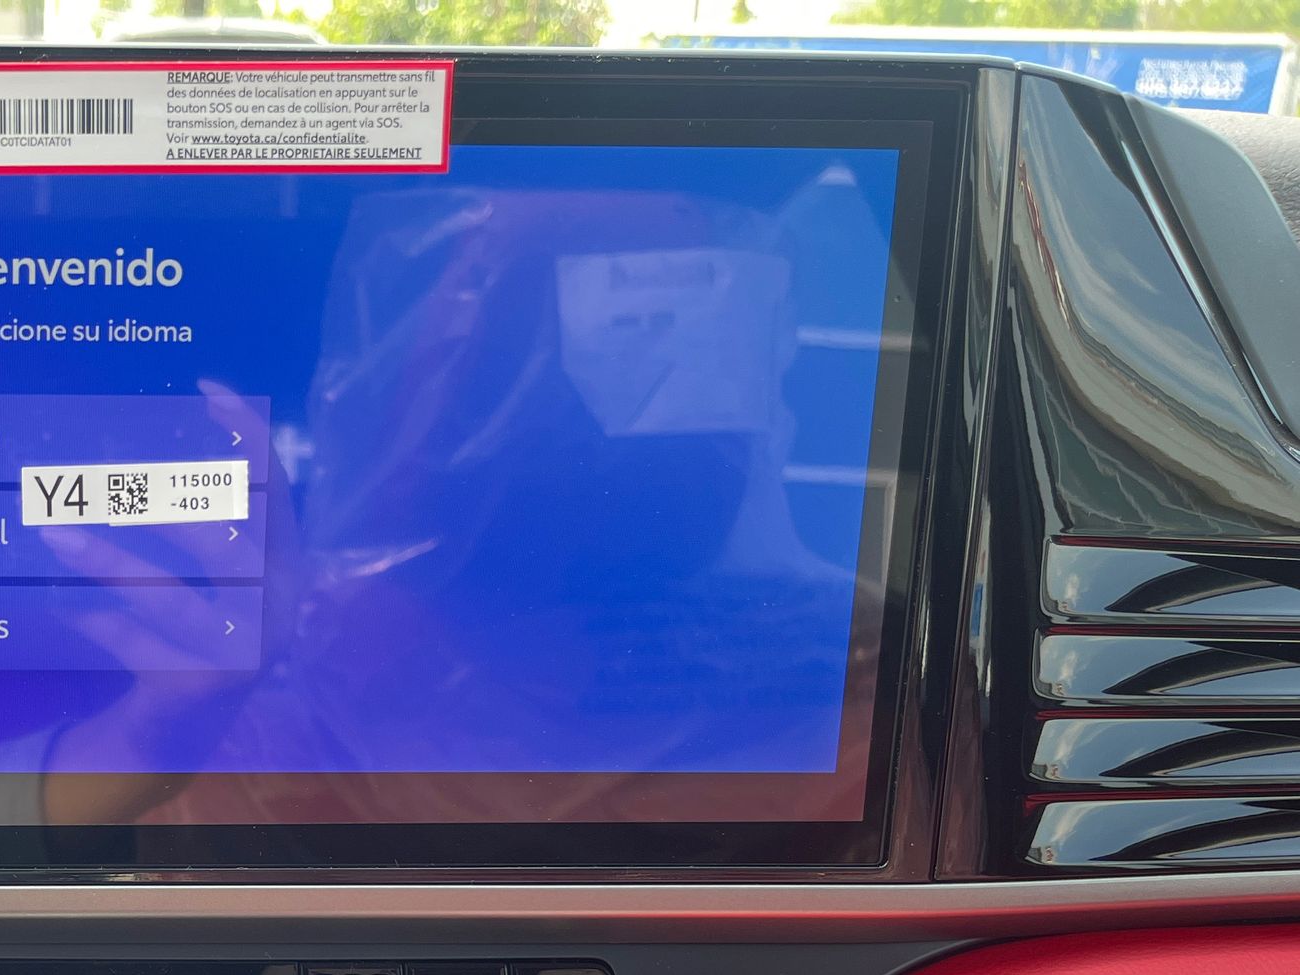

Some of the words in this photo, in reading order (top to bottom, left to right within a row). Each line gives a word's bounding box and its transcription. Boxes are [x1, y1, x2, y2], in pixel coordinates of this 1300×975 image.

[167, 72, 233, 84] REMARQUE:
[235, 72, 263, 83] Votre
[265, 72, 308, 83] véhicule
[310, 73, 335, 84] peut
[337, 72, 397, 83] transmettre
[399, 73, 422, 83] sans
[424, 71, 435, 82] fil
[167, 87, 187, 99] des
[189, 87, 236, 98] données
[238, 87, 252, 98] de
[255, 87, 316, 98] localisation
[319, 89, 333, 98] en
[335, 89, 386, 100] appuyant
[389, 89, 405, 98] sur
[407, 87, 418, 98] le
[167, 103, 207, 113] bouton
[209, 103, 232, 113] SOS
[235, 104, 249, 113] ou
[252, 104, 265, 113] en
[267, 104, 285, 113] cas
[288, 103, 301, 113] de
[304, 103, 351, 113] collision.
[354, 103, 379, 113] Pour
[382, 103, 417, 113] arrêter
[420, 102, 430, 113] la
[167, 118, 237, 130] transmission,
[240, 118, 297, 128] demandez
[300, 118, 306, 128] à
[309, 120, 323, 128] un
[325, 119, 356, 131] agent
[356, 118, 374, 128] via
[377, 118, 402, 128] SOS.
[166, 133, 189, 144] Voir
[191, 132, 369, 145] www.toyota.ca/confidentialite.
[166, 148, 176, 160] A
[178, 148, 228, 159] ENLEVER
[231, 148, 252, 159] PAR
[254, 148, 267, 159] LE
[270, 148, 351, 159] PROPRIETAIRE
[354, 148, 421, 159] SEULEMENT
[73, 323, 100, 342] su
[108, 319, 193, 343] idioma
[170, 473, 232, 488] 115000
[34, 474, 89, 517] Y4
[170, 497, 210, 510] -403
